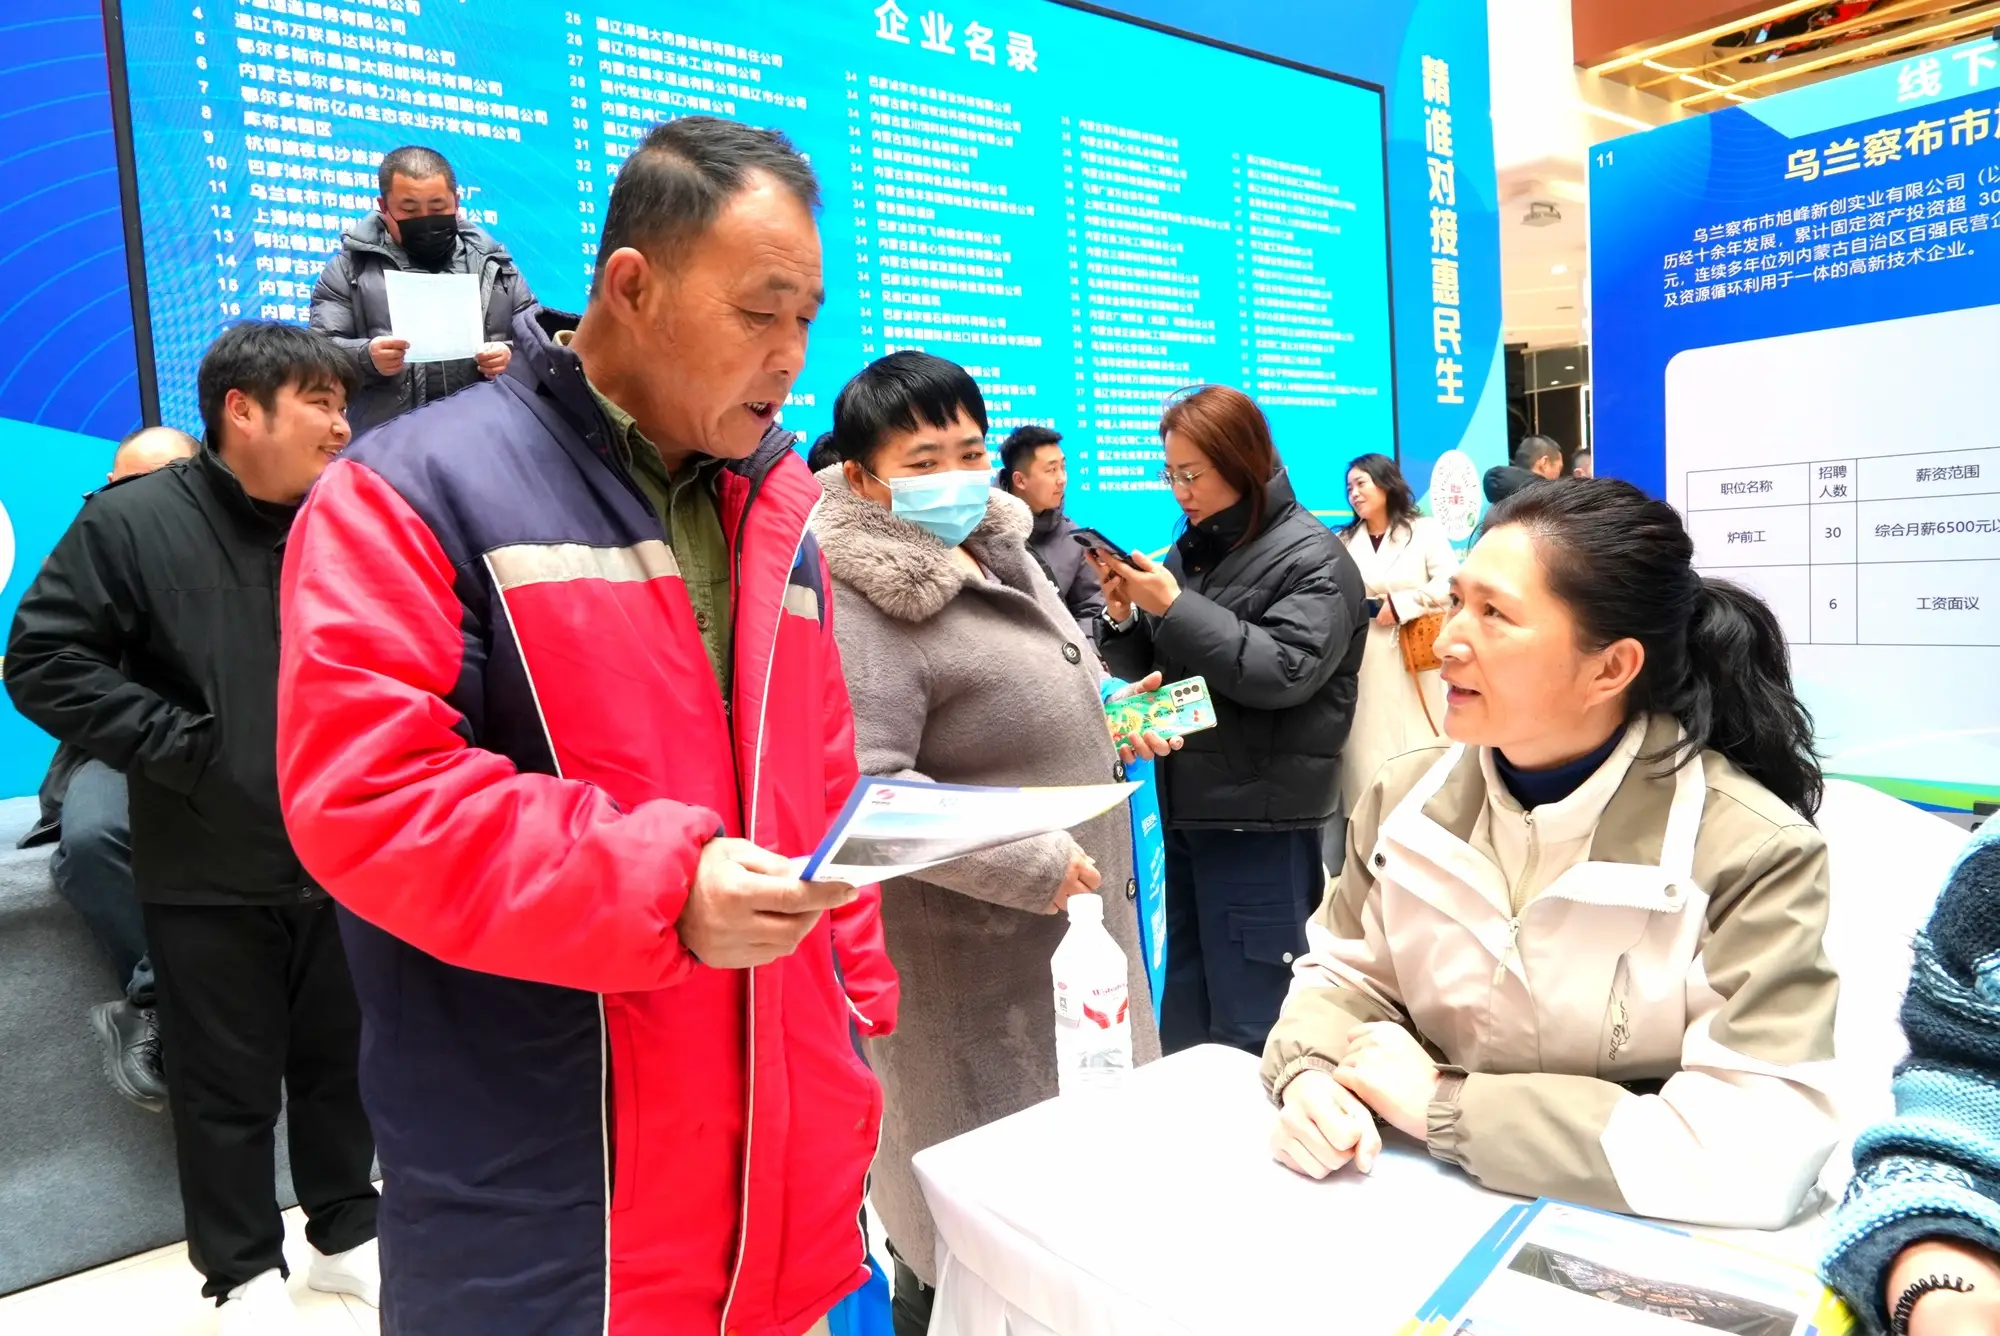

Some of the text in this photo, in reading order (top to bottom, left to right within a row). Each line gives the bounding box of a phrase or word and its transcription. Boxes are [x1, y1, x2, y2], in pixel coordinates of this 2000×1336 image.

[192, 6, 204, 20] 4
[194, 31, 206, 45] 5
[566, 32, 583, 46] 26
[873, 0, 1038, 73] 企业名录
[196, 55, 208, 70] 6
[568, 54, 584, 66] 27
[1897, 42, 1999, 102] 线下
[198, 80, 209, 94] 7
[200, 105, 212, 120] 8
[573, 117, 589, 130] 30
[202, 130, 214, 144] 9
[575, 138, 589, 150] 31
[1784, 102, 2000, 182] 乌兰察布市
[205, 155, 228, 171] 10
[576, 159, 591, 172] 32
[1596, 150, 1614, 168] 11
[208, 179, 227, 194] 11
[577, 179, 593, 193] 33
[210, 204, 232, 219] 12
[579, 201, 595, 214] 33
[581, 221, 596, 234] 33
[1421, 55, 1465, 404] 精准对接惠民生
[1663, 195, 1966, 270] 历经十余年发展，累计固定资产投资超
[212, 228, 235, 244] 13
[582, 242, 598, 255] 33
[215, 253, 239, 269] 14
[1663, 240, 1976, 308] 及资源循环利用于一体的高新技术企业。
[1818, 465, 1848, 480] 招聘
[1915, 464, 1980, 482] 薪资范围
[1720, 480, 1773, 495] 职位名称
[1818, 484, 1848, 498] 人数
[1727, 530, 1767, 544] 炉前工
[1824, 526, 1842, 539] 30
[1828, 598, 1838, 611] 6
[1916, 596, 1980, 612] 工资面议
